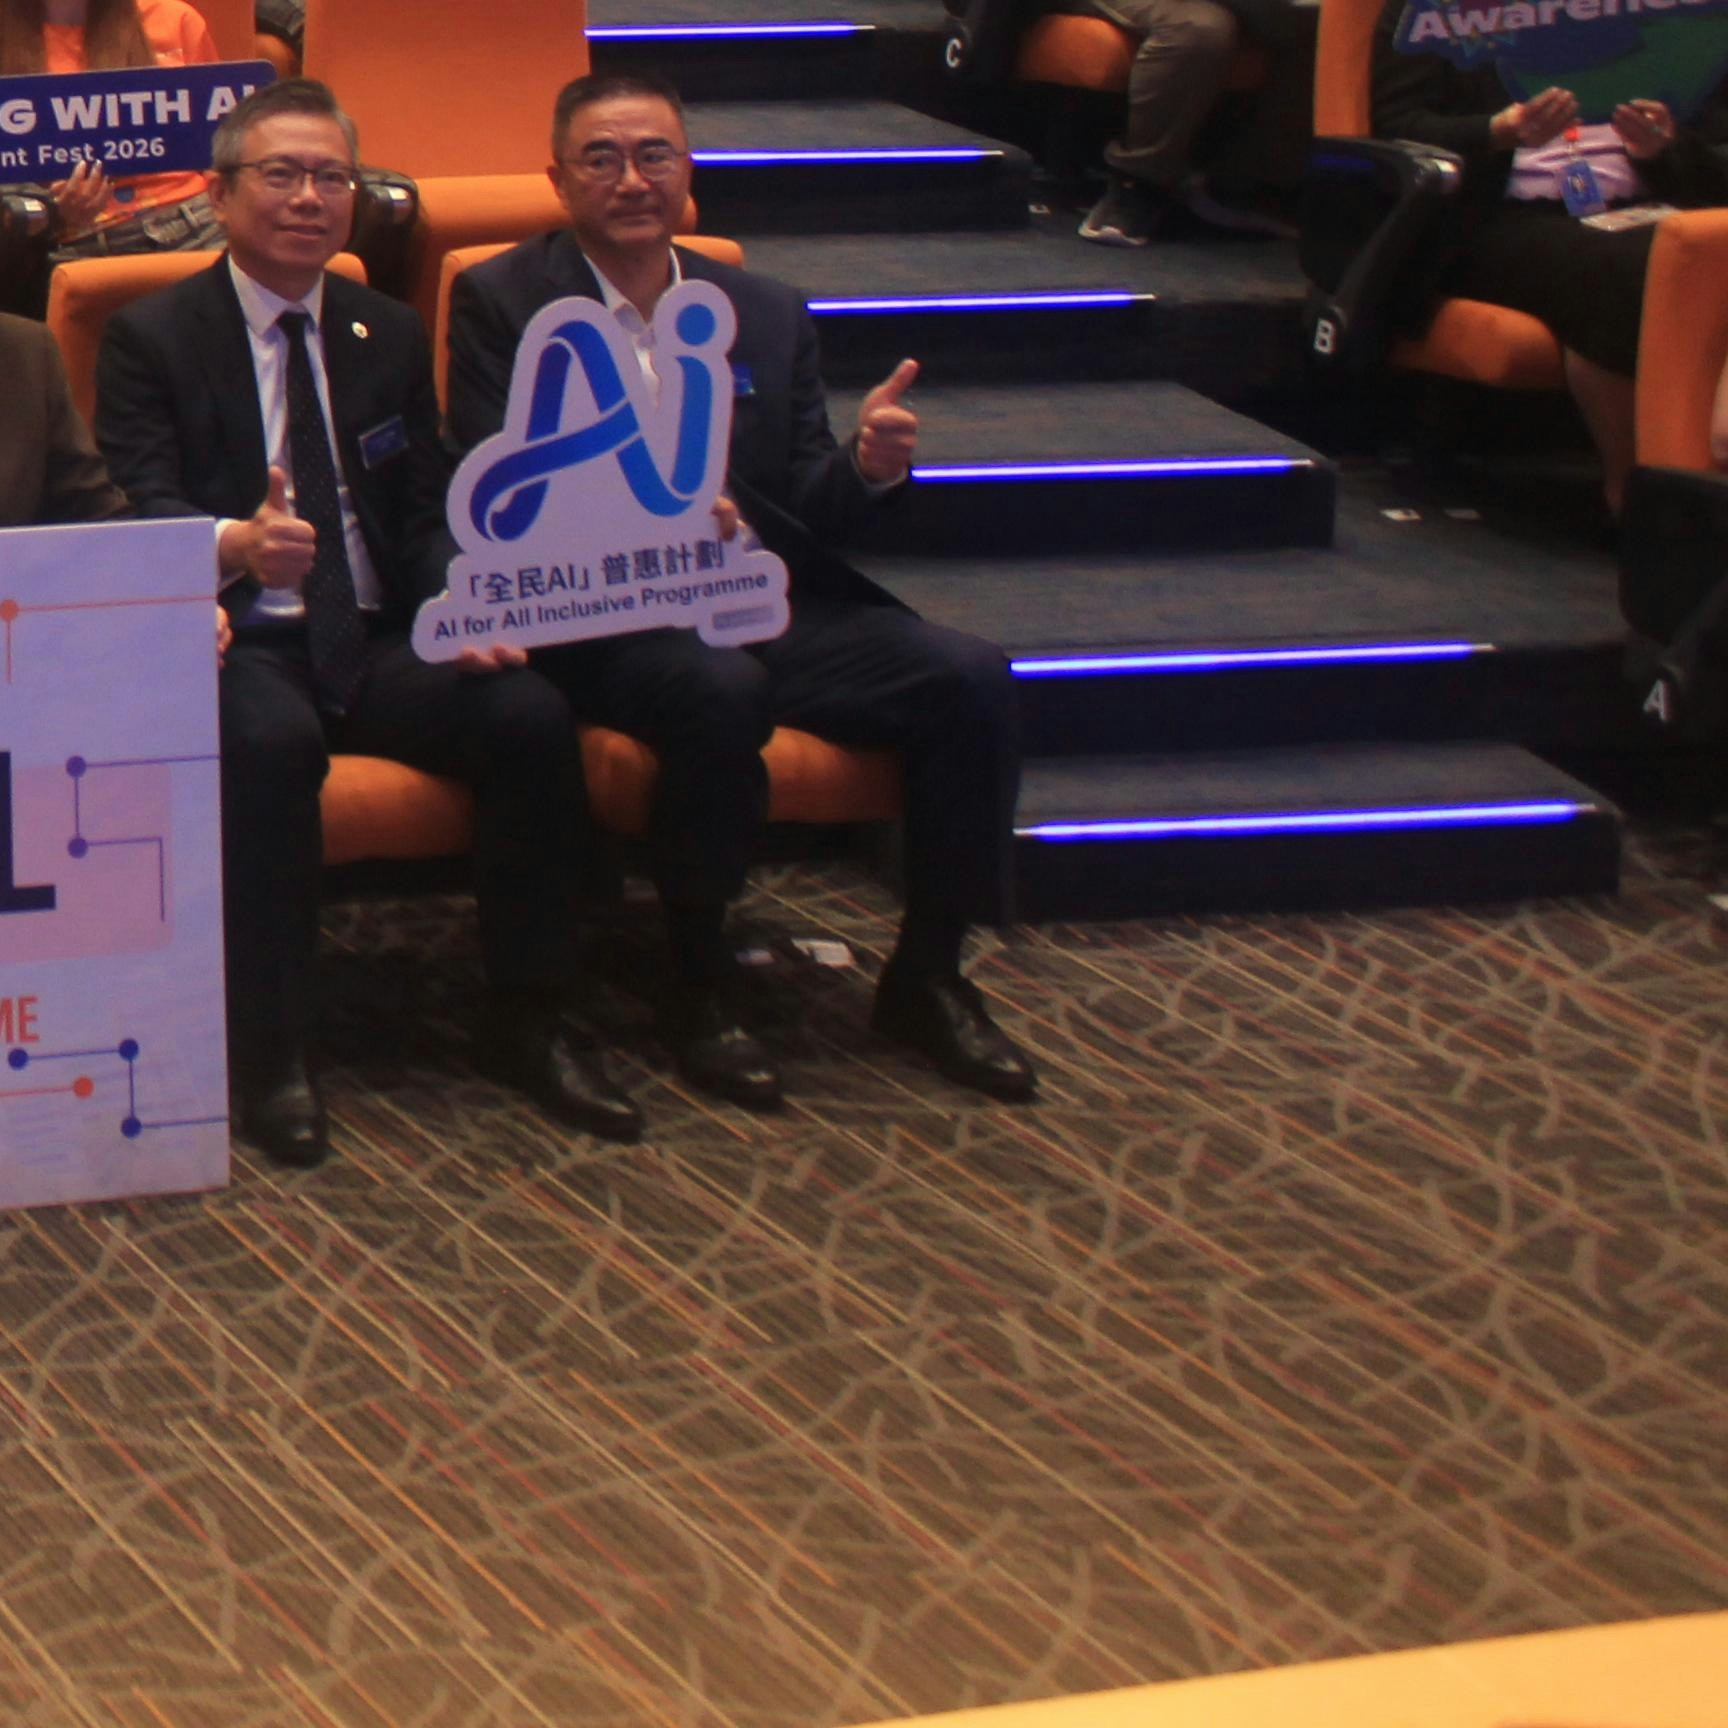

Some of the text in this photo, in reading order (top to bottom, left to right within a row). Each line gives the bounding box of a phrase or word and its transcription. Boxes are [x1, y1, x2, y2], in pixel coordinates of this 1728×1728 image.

[946, 37, 962, 69] C
[51, 90, 191, 130] WITH
[38, 144, 95, 165] Fest
[104, 137, 165, 161] 2026
[1314, 318, 1337, 354] B
[434, 573, 769, 641] AI for All Inclusive Programme
[1643, 678, 1666, 723] A
